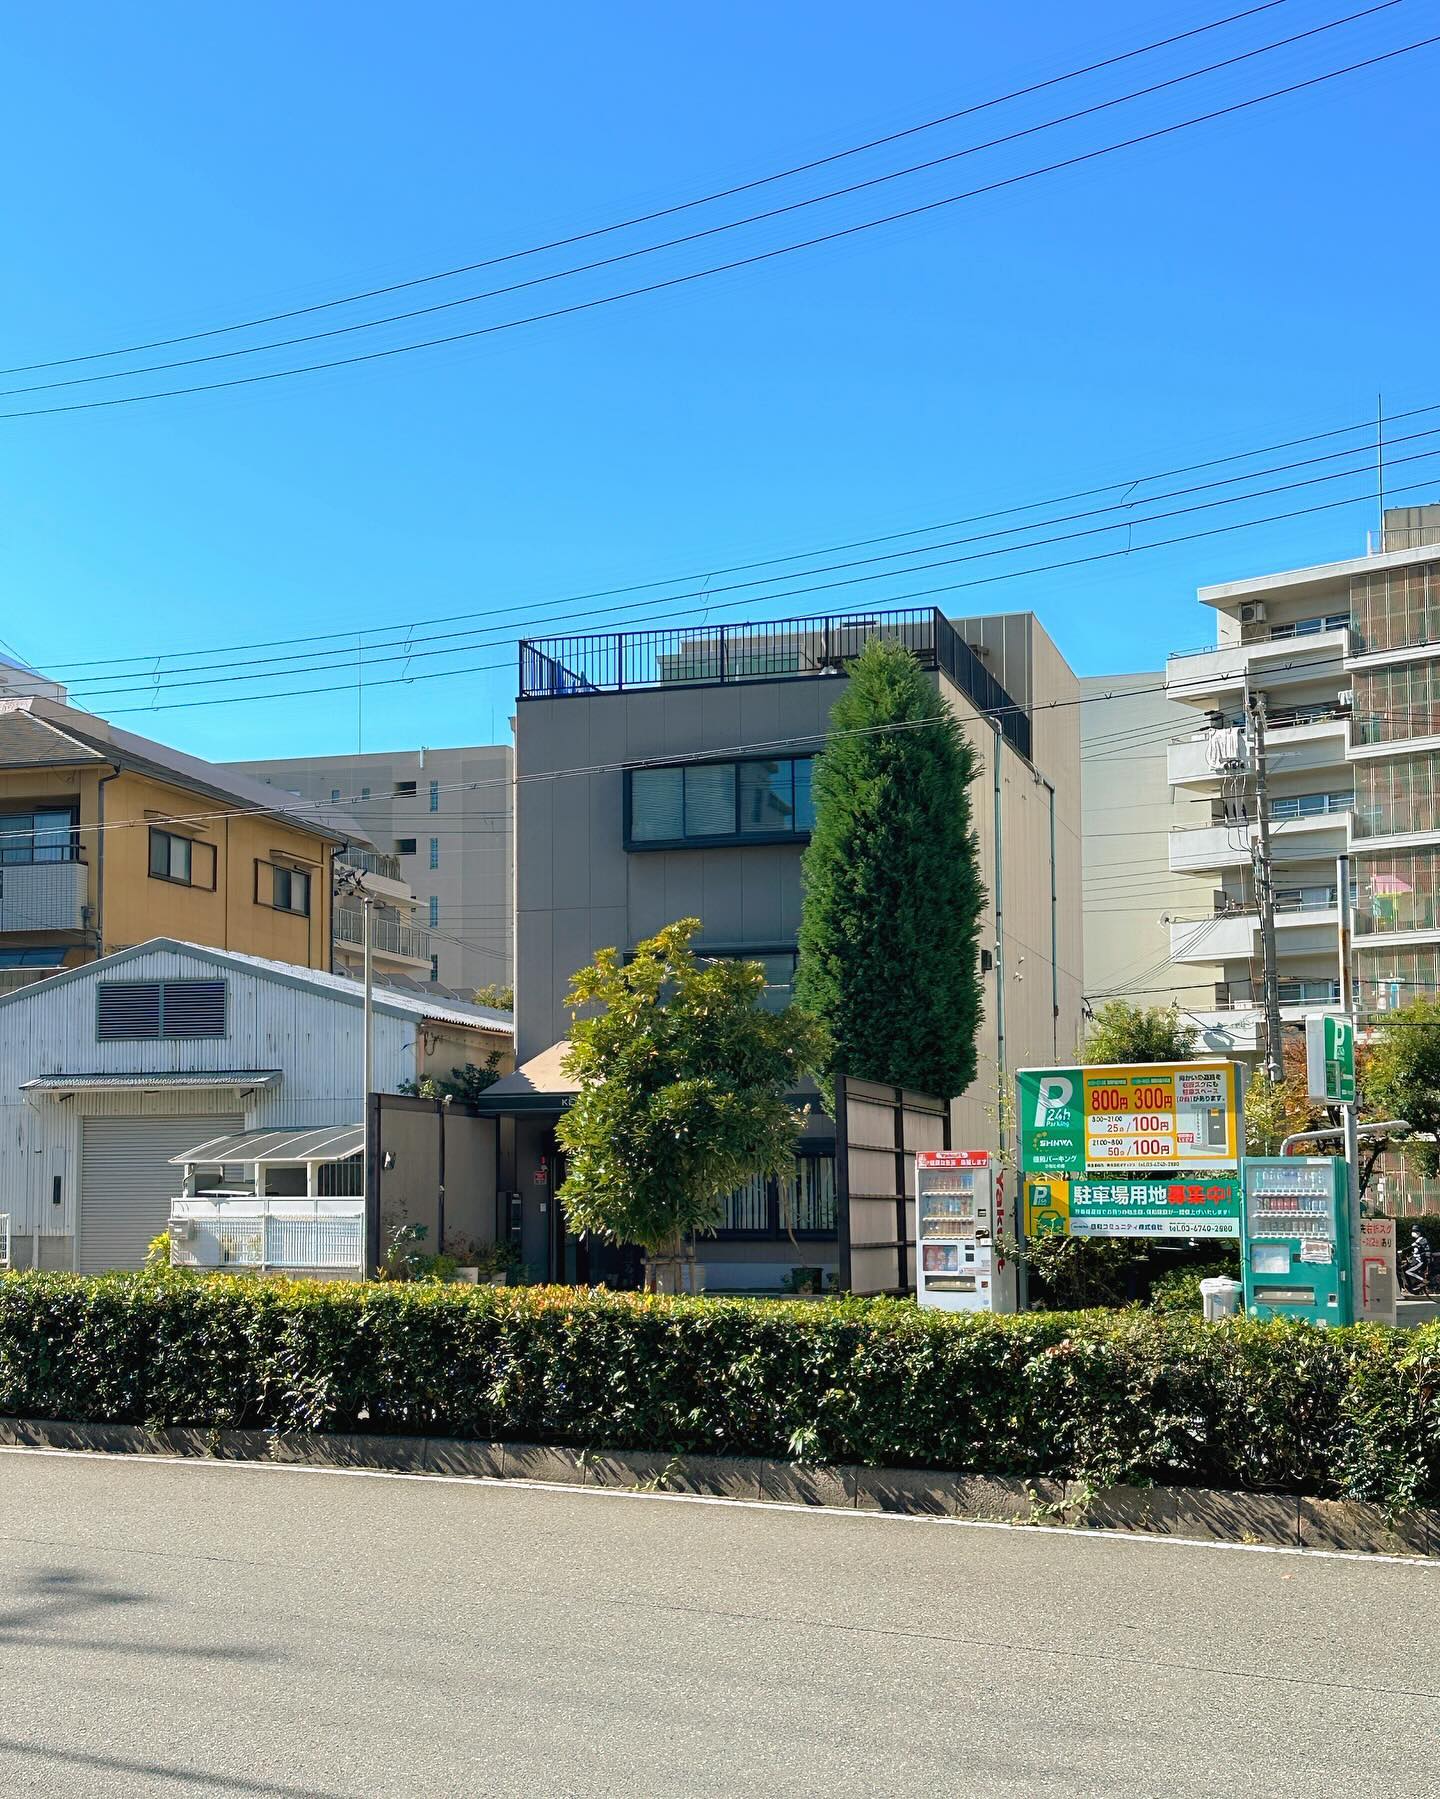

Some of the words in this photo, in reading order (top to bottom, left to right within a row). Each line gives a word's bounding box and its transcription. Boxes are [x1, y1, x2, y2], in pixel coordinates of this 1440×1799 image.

[1334, 1020, 1345, 1060] P
[1034, 1077, 1073, 1127] P
[1092, 1089, 1128, 1110] 800円
[1134, 1087, 1173, 1109] 300円
[1046, 1120, 1070, 1128] Parking
[1047, 1109, 1071, 1121] 24h
[1033, 1186, 1048, 1206] P
